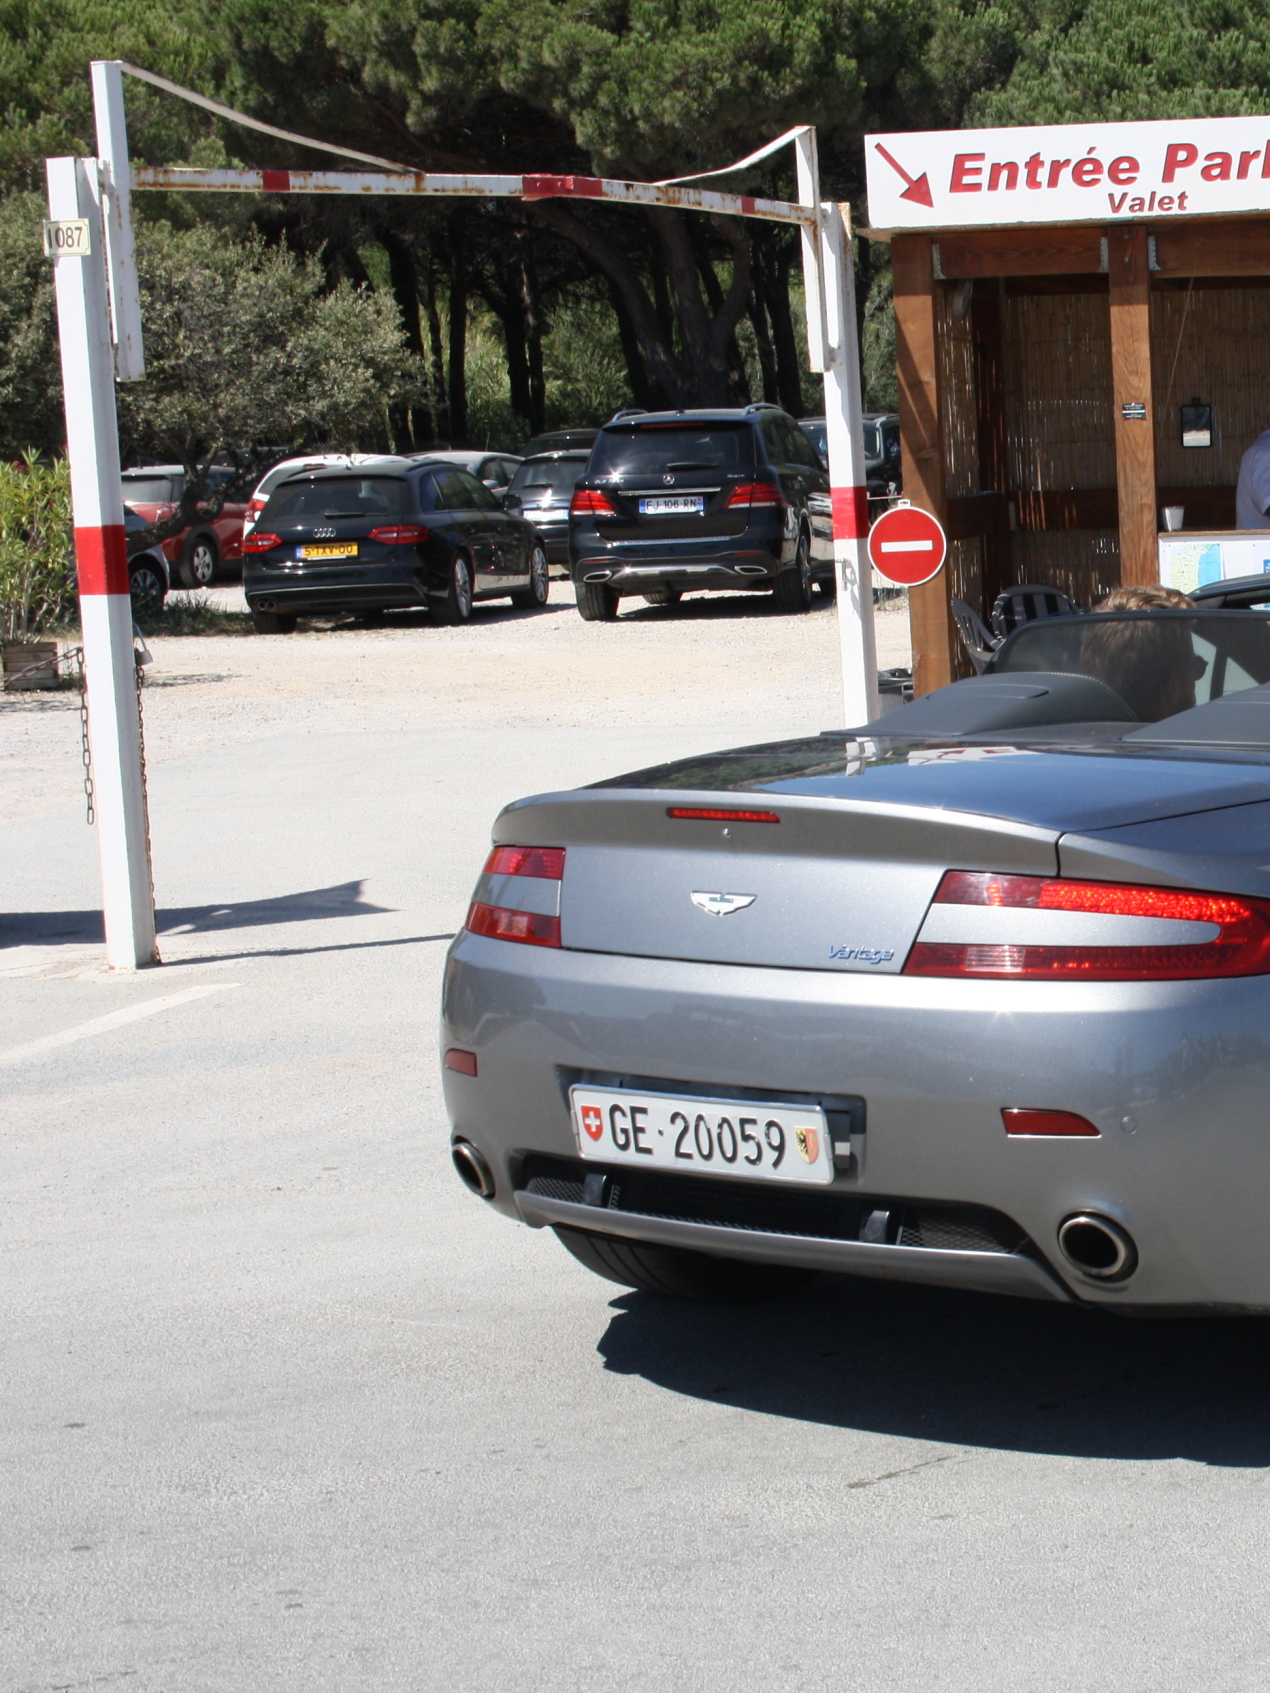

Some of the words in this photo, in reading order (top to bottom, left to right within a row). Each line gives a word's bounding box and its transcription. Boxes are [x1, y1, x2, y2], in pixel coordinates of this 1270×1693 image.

[949, 146, 1141, 193] Entrée
[1107, 190, 1189, 214] Valet
[828, 944, 894, 964] Vantage
